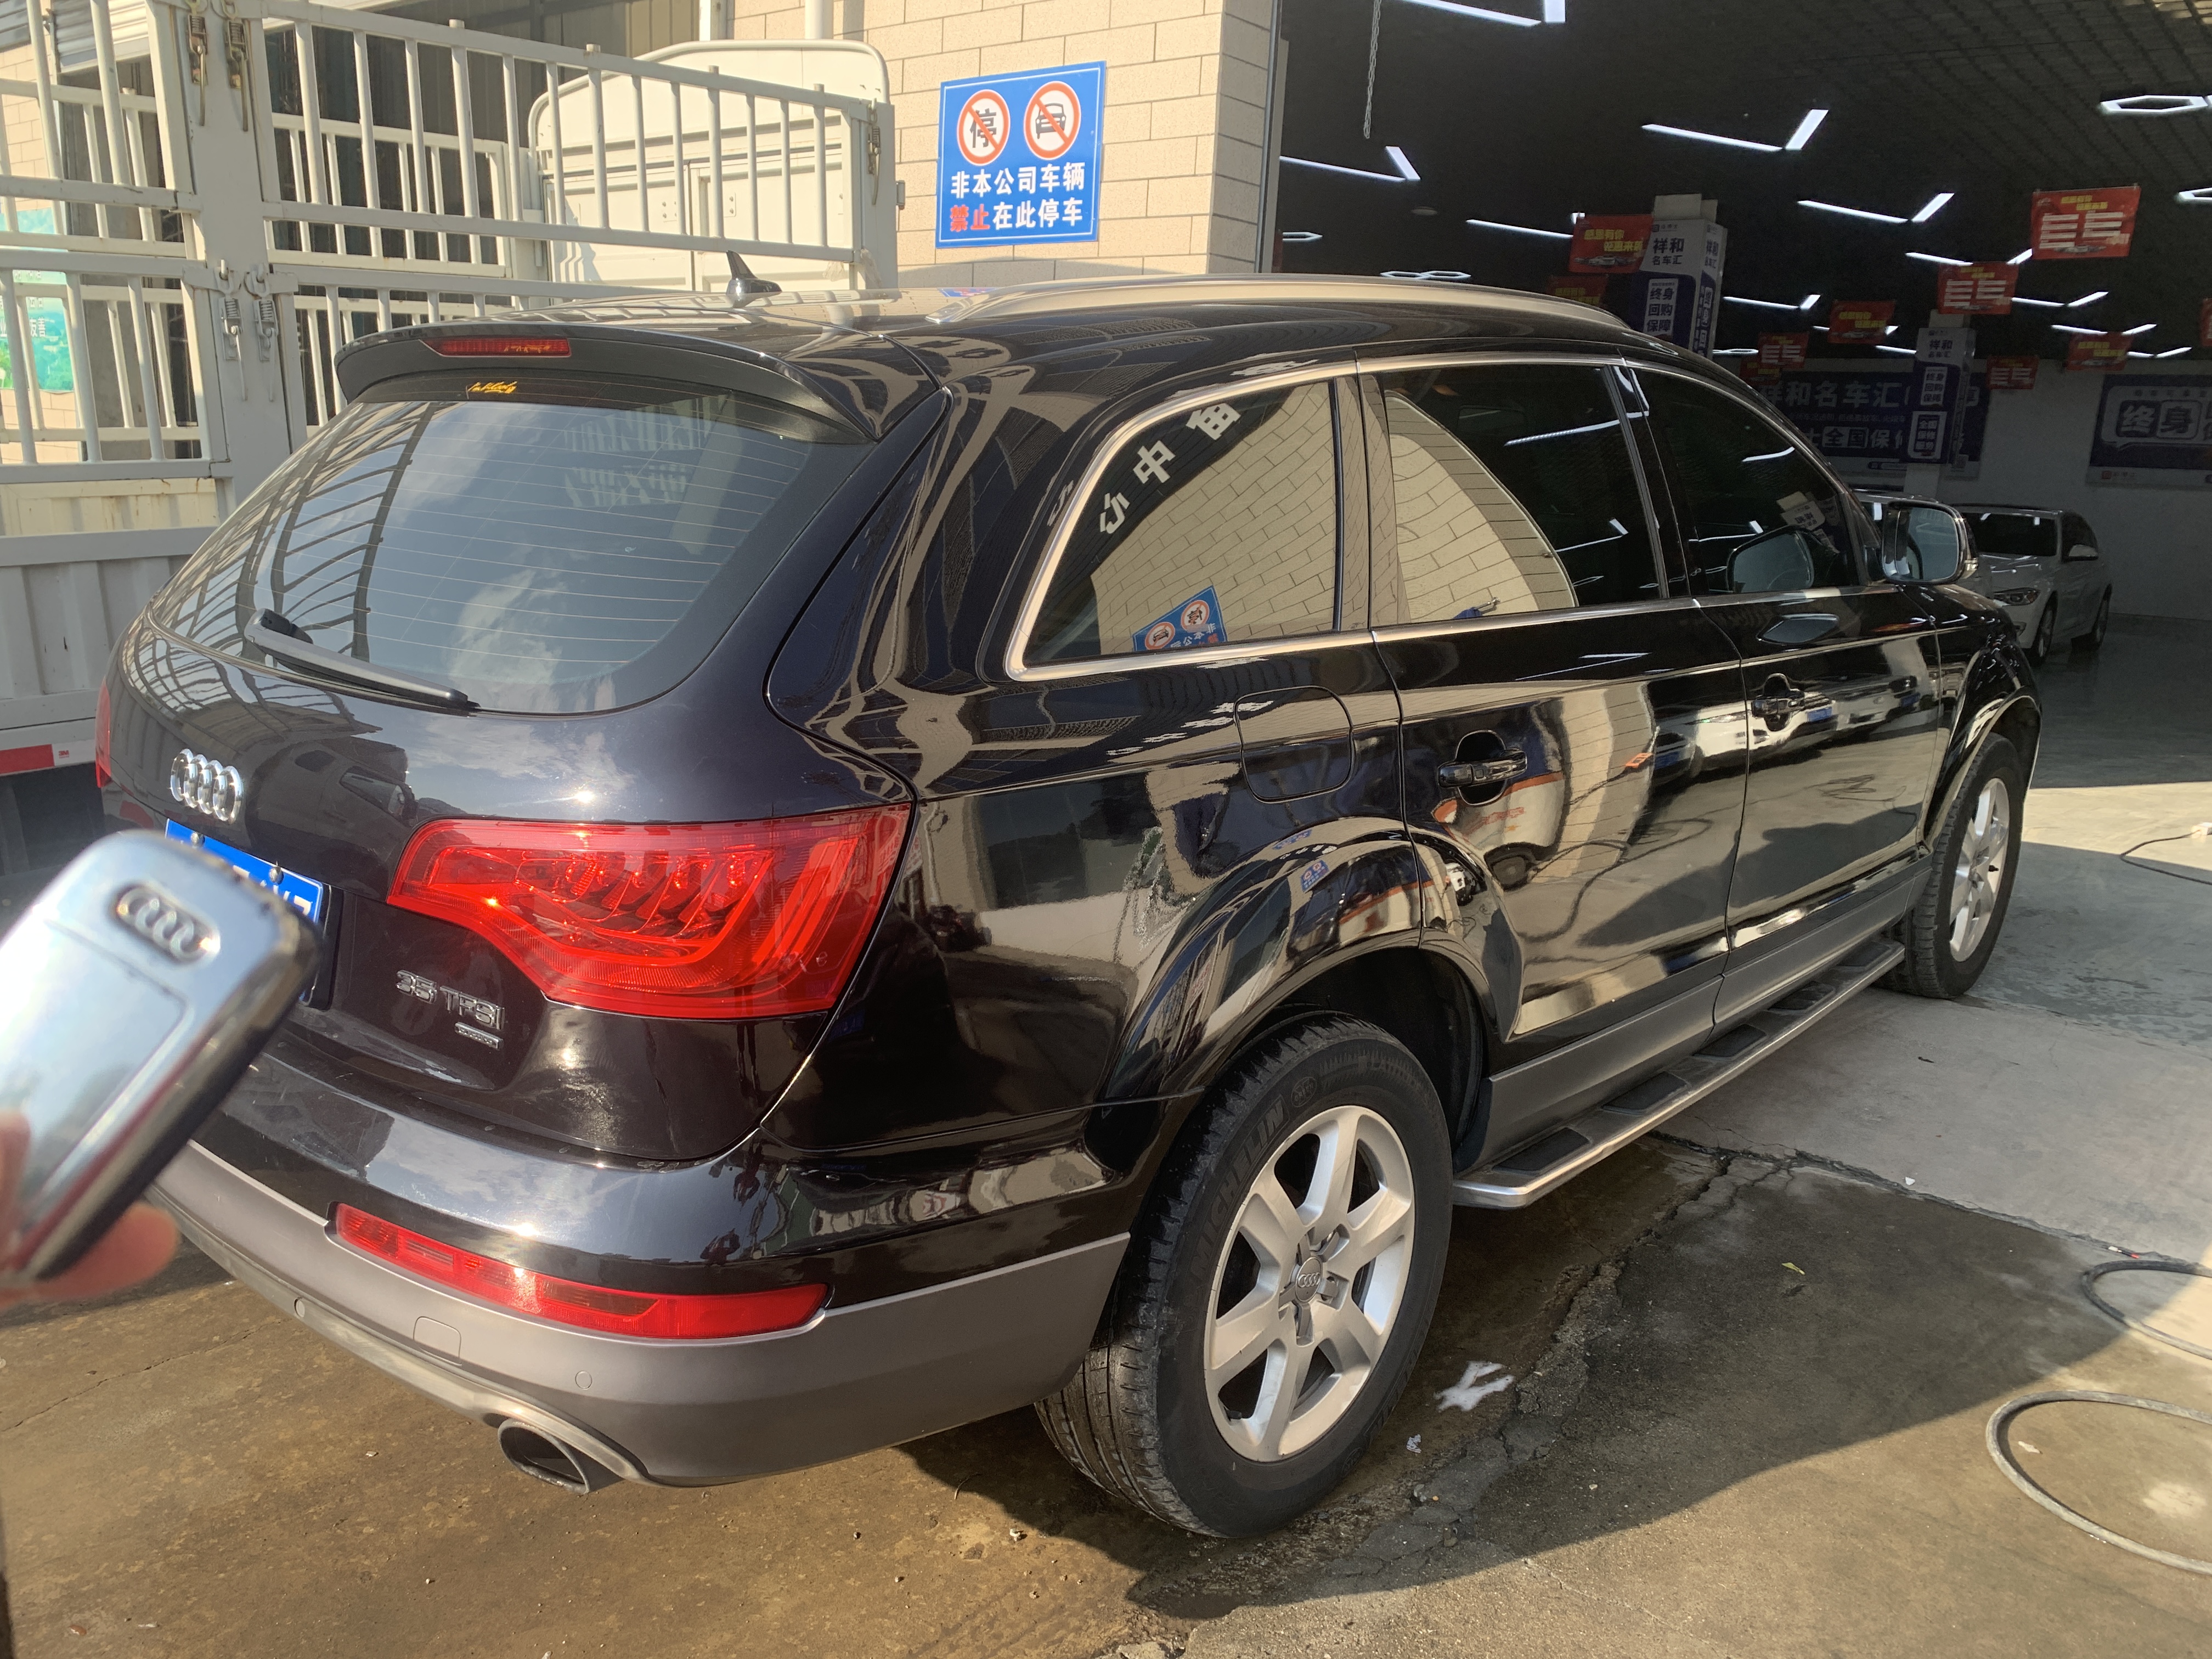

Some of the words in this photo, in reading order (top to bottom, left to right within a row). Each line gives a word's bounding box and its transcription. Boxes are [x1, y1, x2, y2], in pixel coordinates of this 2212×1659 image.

[950, 162, 1086, 199] 非本公司车辆
[950, 197, 1083, 233] 禁止在此停车
[1652, 237, 1684, 254] 祥和
[1651, 255, 1683, 266] 名车汇
[1650, 287, 1674, 300] 终身
[1649, 303, 1673, 317] 回购
[1646, 319, 1671, 332] 保障
[1929, 339, 1953, 350] 祥和
[396, 969, 438, 1004] 35
[439, 985, 505, 1031] TFSI
[1189, 1099, 1285, 1279] MICHELIN
